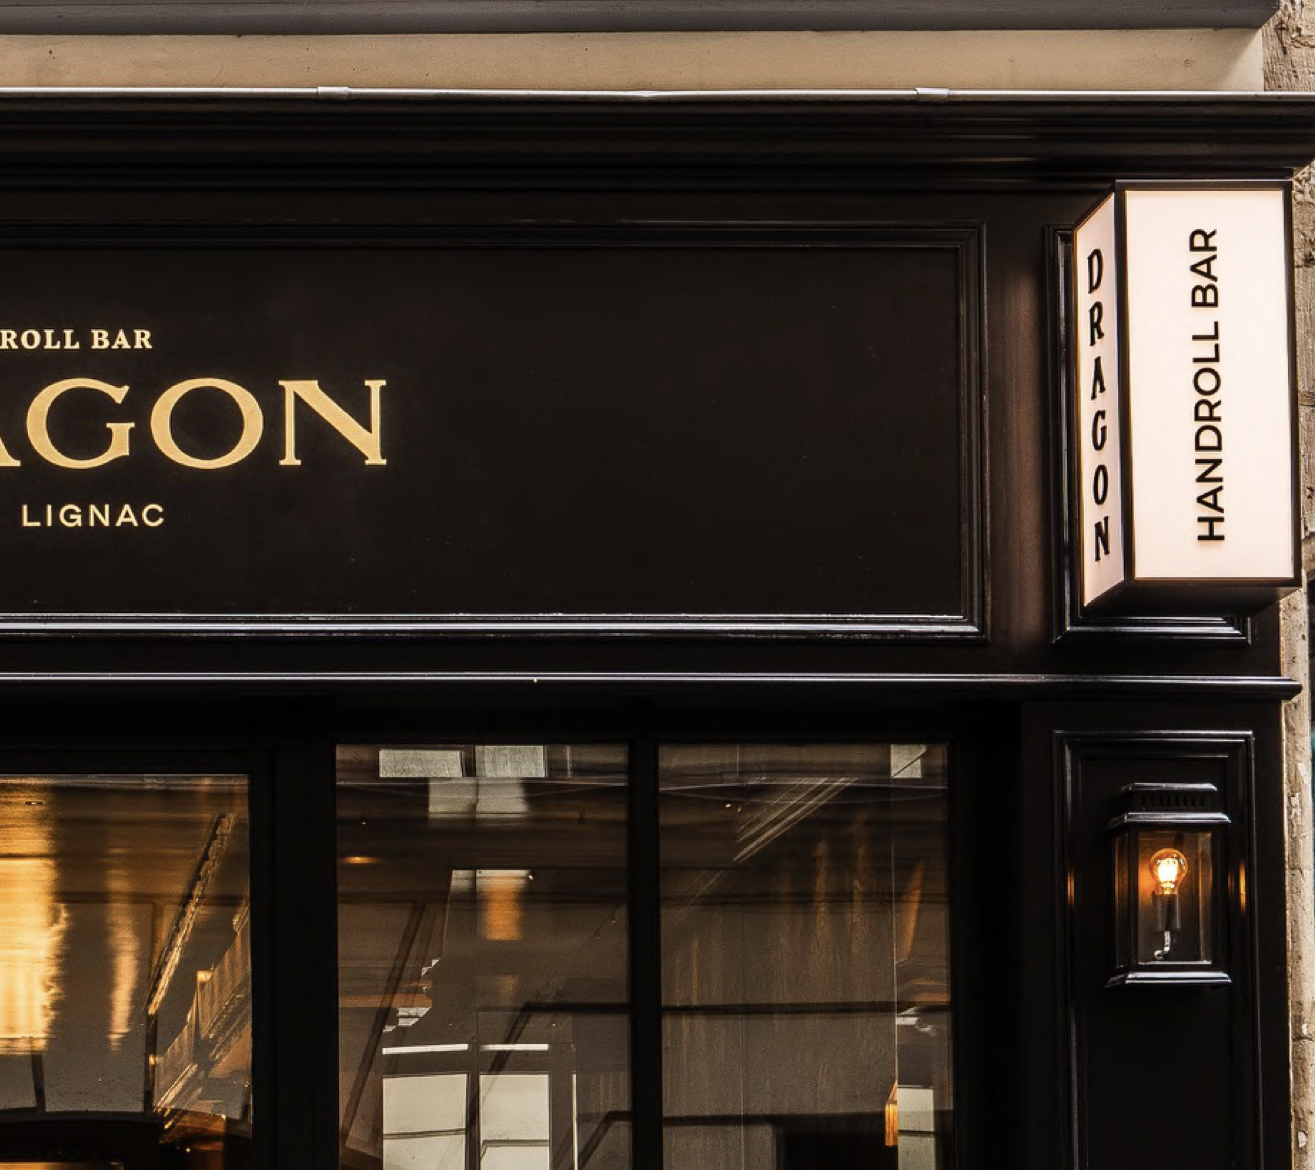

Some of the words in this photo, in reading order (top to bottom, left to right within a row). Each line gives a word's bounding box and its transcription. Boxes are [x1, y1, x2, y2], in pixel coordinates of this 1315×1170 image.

[1189, 228, 1219, 308] BAR
[90, 329, 153, 350] BAR
[1087, 248, 1110, 562] DRAGON
[1192, 321, 1225, 541] HANDROLL
[22, 504, 166, 528] LIGNAC
